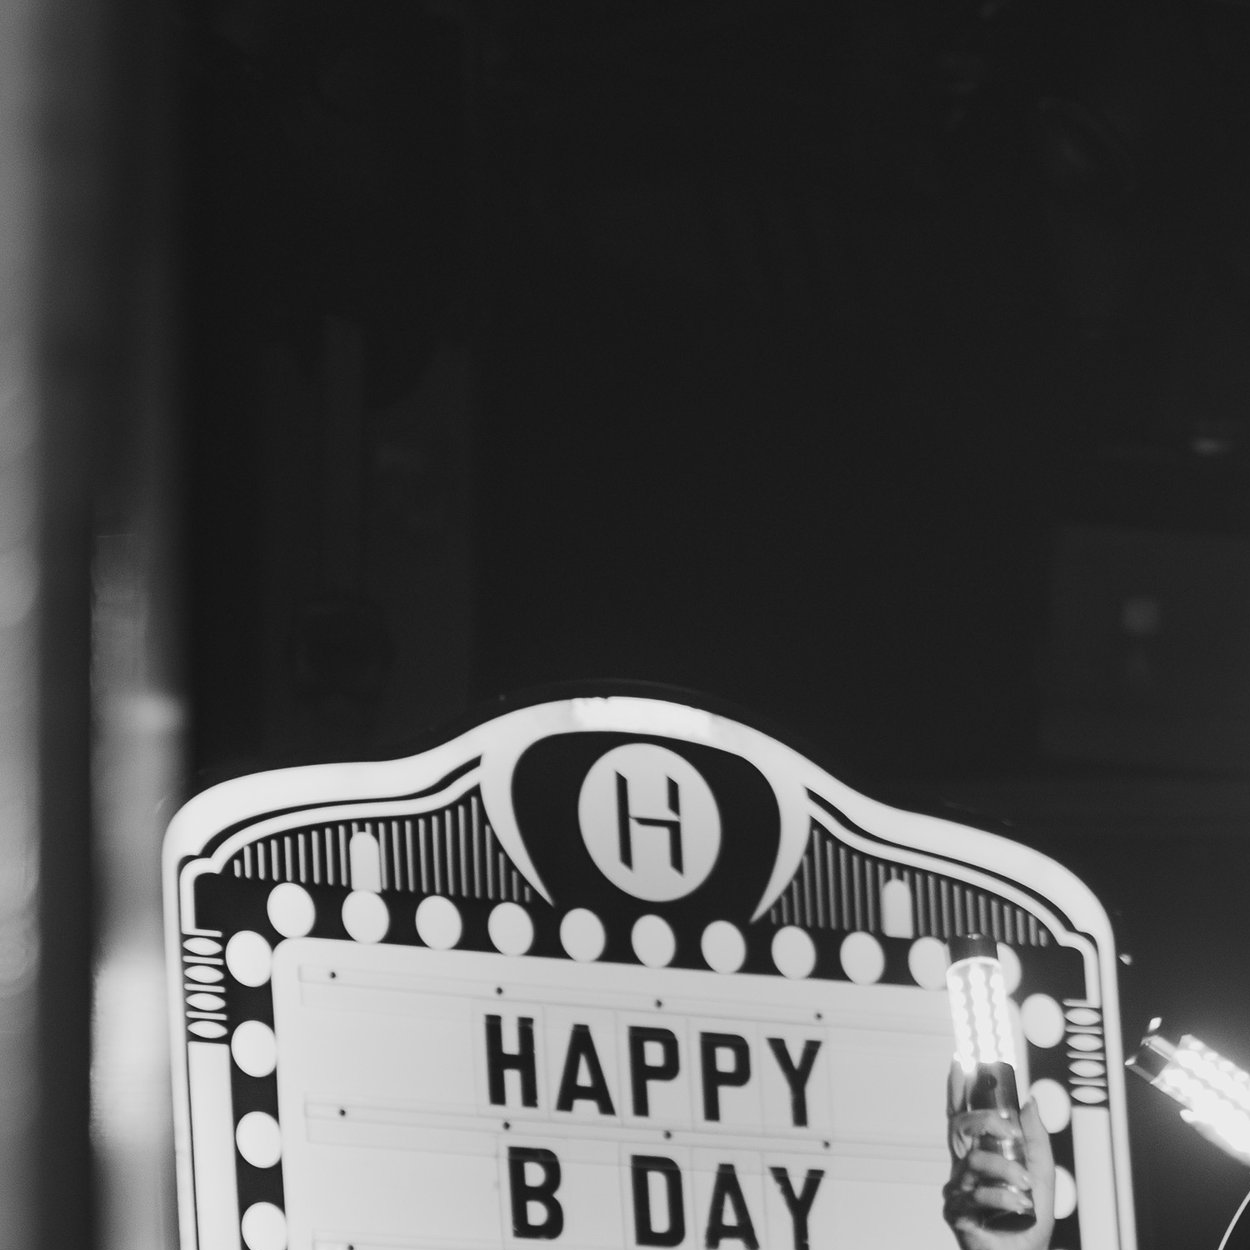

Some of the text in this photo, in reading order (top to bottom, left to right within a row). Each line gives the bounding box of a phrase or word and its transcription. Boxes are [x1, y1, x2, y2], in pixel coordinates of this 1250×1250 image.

[614, 770, 684, 876] H
[485, 1013, 822, 1128] HAPPY
[507, 1145, 565, 1240] B
